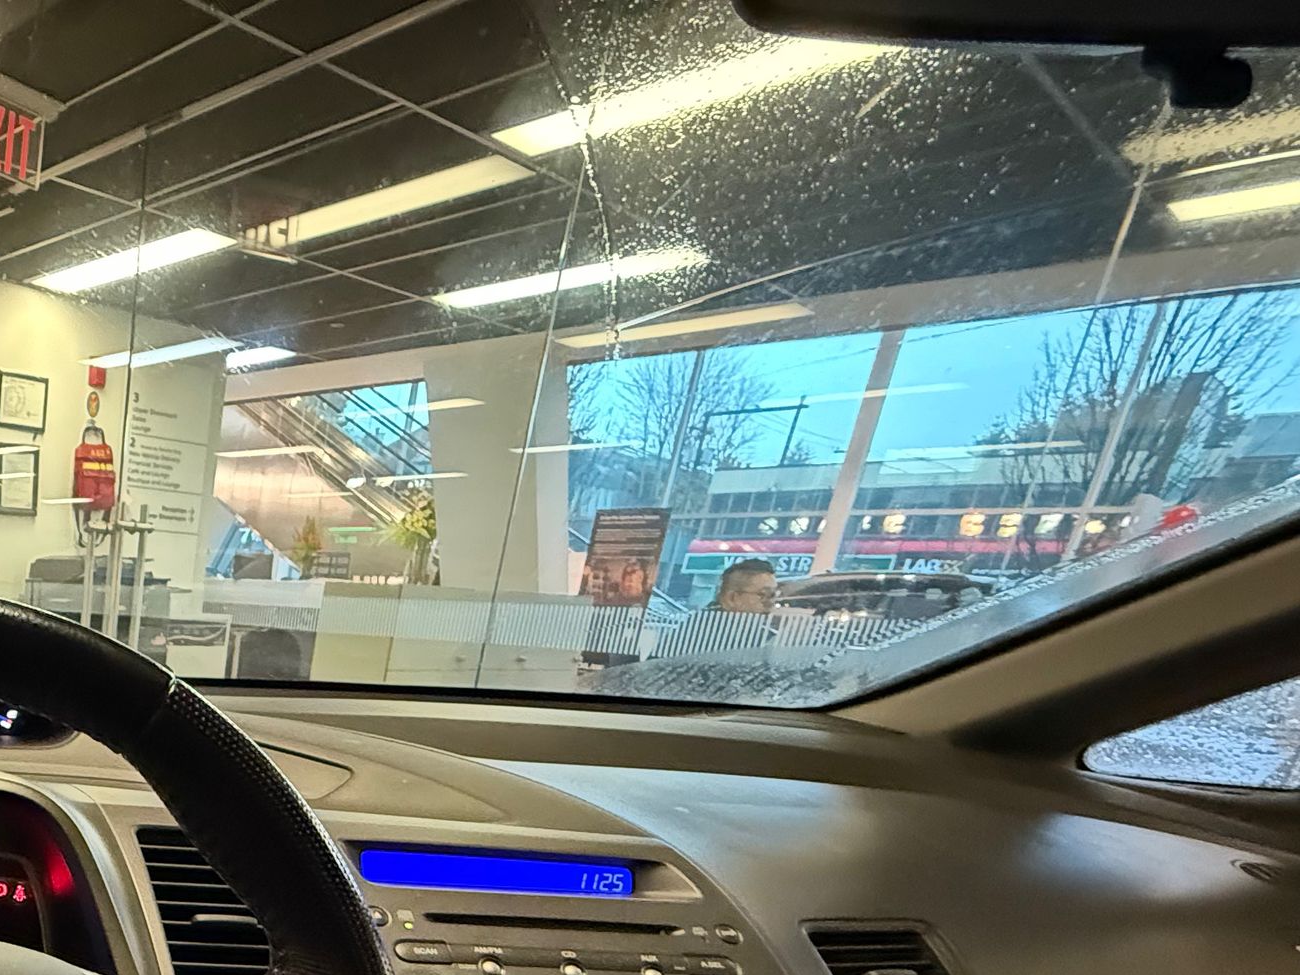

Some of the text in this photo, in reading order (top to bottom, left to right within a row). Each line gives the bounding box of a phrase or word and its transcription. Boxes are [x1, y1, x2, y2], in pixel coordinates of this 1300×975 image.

[132, 391, 140, 403] 3
[129, 436, 136, 448] 2
[413, 946, 438, 955] SCAN
